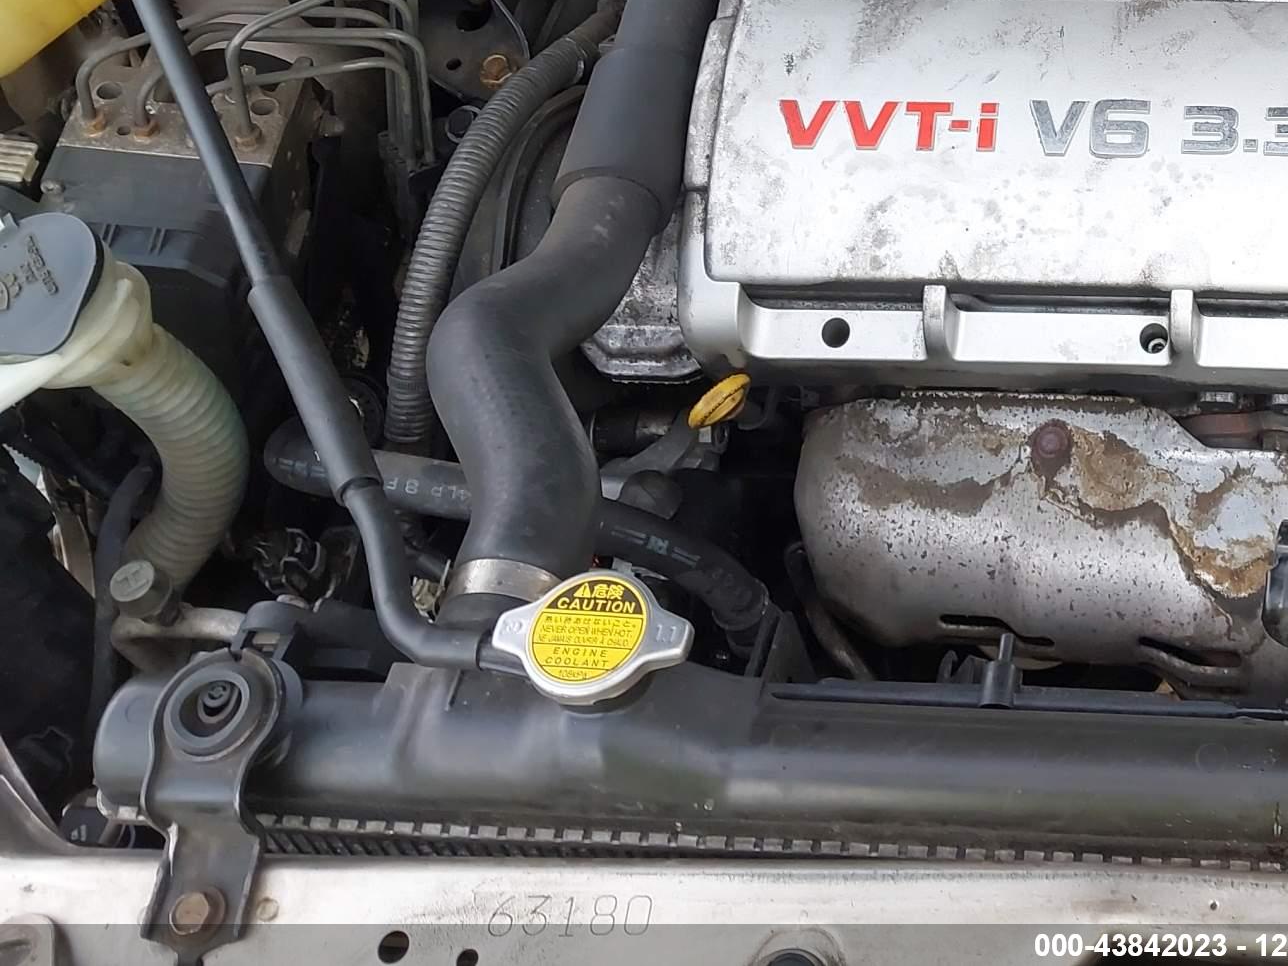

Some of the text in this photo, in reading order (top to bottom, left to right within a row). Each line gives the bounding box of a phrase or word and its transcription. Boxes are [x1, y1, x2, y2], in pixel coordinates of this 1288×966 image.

[779, 99, 1000, 152] VVT-i
[1029, 98, 1152, 158] V6
[592, 584, 625, 599] 危険
[557, 597, 636, 613] CAUTION
[553, 646, 609, 658] ENGINE
[545, 656, 609, 667] COOLANT
[487, 894, 653, 938] 63180
